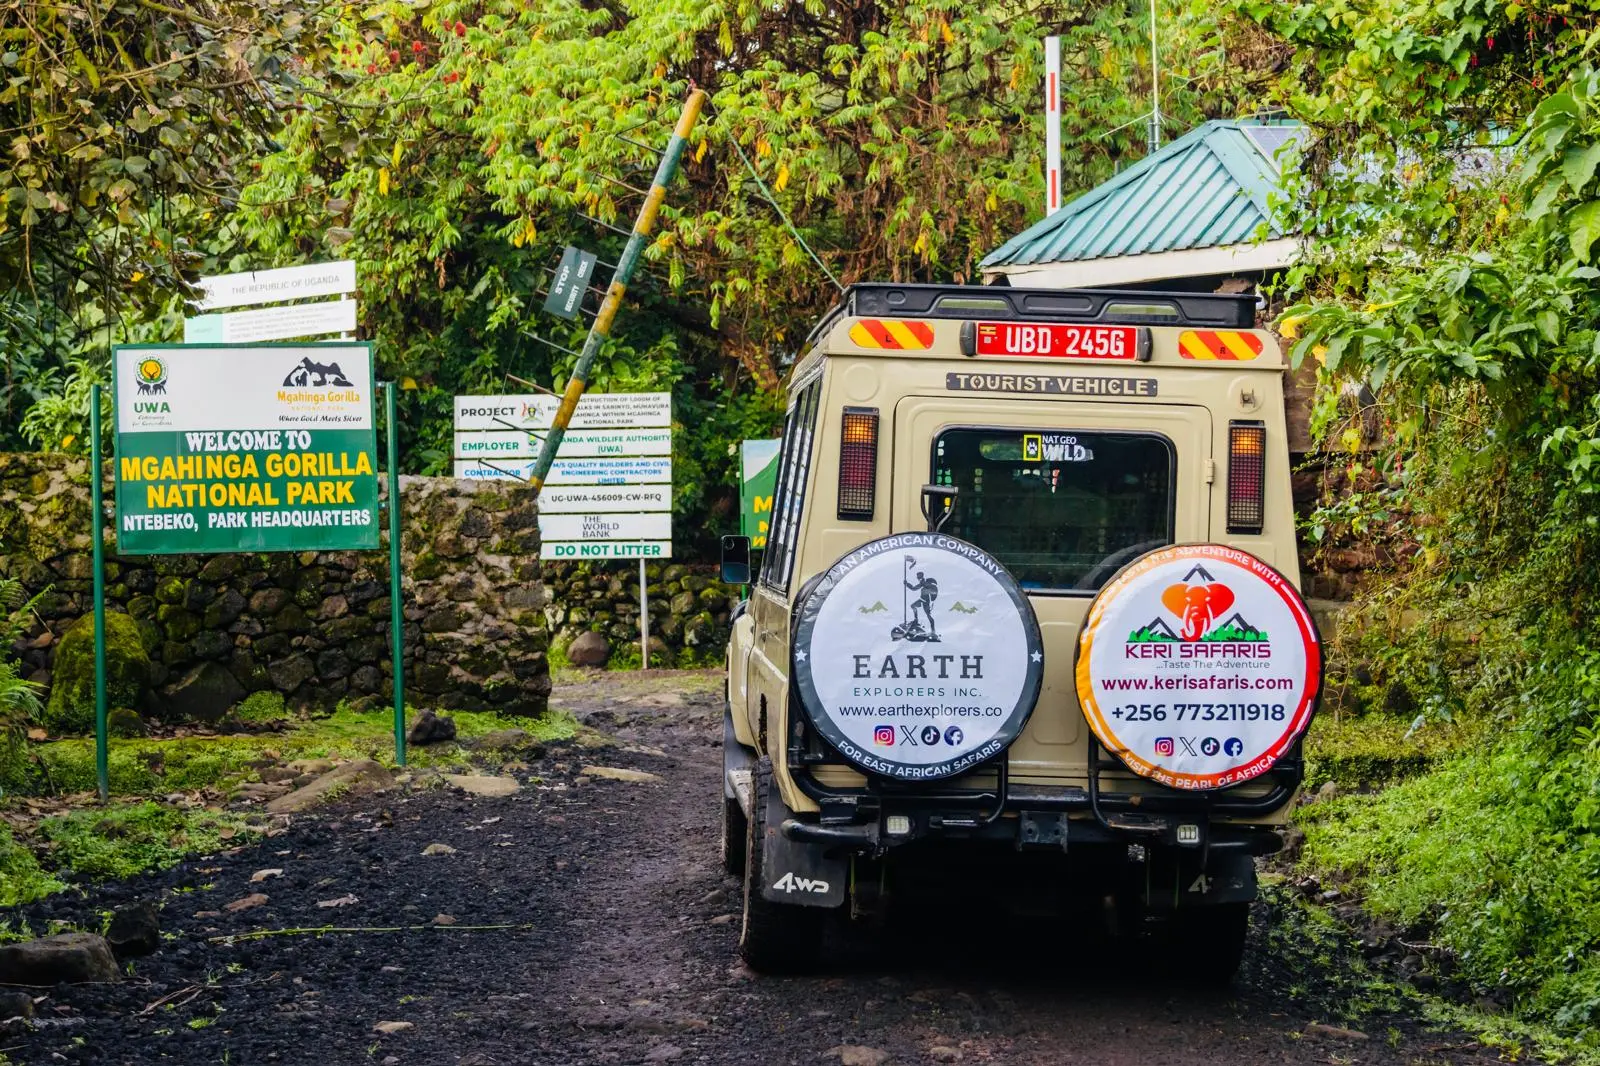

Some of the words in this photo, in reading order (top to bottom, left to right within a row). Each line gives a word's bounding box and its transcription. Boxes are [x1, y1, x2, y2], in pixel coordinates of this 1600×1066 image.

[232, 286, 245, 294] THE
[249, 281, 289, 292] REPUBLIC
[291, 279, 303, 288] OF
[305, 275, 340, 287] UGANDA
[555, 266, 570, 294] STOP
[1006, 326, 1051, 354] UBD
[1066, 328, 1124, 356] 245G
[956, 374, 1050, 391] TOURIST
[1057, 378, 1149, 394] VEHICLE
[277, 391, 325, 404] Mgahinga
[328, 391, 360, 402] Gorilla
[134, 402, 171, 413] UWA
[461, 407, 516, 417] PROJECT
[185, 431, 281, 452] WELCOME
[285, 430, 312, 450] TO
[462, 442, 519, 451] EMPLOYER
[1042, 435, 1060, 444] NAT
[1060, 436, 1077, 445] GEO
[1042, 443, 1086, 461] WILD
[121, 454, 259, 481] MGAHINGA
[265, 452, 372, 478] GORILLA
[147, 483, 278, 508] NATIONAL
[287, 480, 355, 505] PARK
[551, 493, 662, 502] UG-UWA-456009-CW-RFQ
[124, 512, 199, 532] NTEBEKO,
[208, 511, 247, 529] PARK
[251, 509, 371, 528] HEADQUARTERS
[555, 545, 576, 556] DO
[581, 545, 609, 556] NOT
[614, 545, 660, 555] LITTER
[838, 556, 859, 575] AN
[859, 536, 933, 561] AMERICAN
[937, 537, 1003, 576] COMPANY
[1175, 547, 1249, 566] ADVENTURE
[1251, 559, 1281, 585] WITH
[1125, 644, 1172, 659] KERI
[1180, 644, 1271, 659] SAFARIS
[852, 655, 984, 679] EARTH
[1193, 660, 1213, 668] The
[1215, 660, 1270, 668] Adventure
[1102, 675, 1293, 690] www.kerisafaris.com
[854, 687, 945, 697] EXPLORERS
[954, 687, 982, 697] INC.
[839, 704, 1002, 719] www.earthexplorers.co
[1111, 704, 1167, 721] +256
[1174, 703, 1285, 721] 773211918
[838, 740, 862, 761] FOR
[862, 756, 894, 774] EAST
[896, 764, 951, 777] AFRICAN
[953, 739, 1002, 771] SAFARIS
[1123, 752, 1150, 776] VISIT
[1217, 774, 1233, 786] OF
[1236, 755, 1277, 781] AFRICA
[773, 872, 829, 893] 4WD
